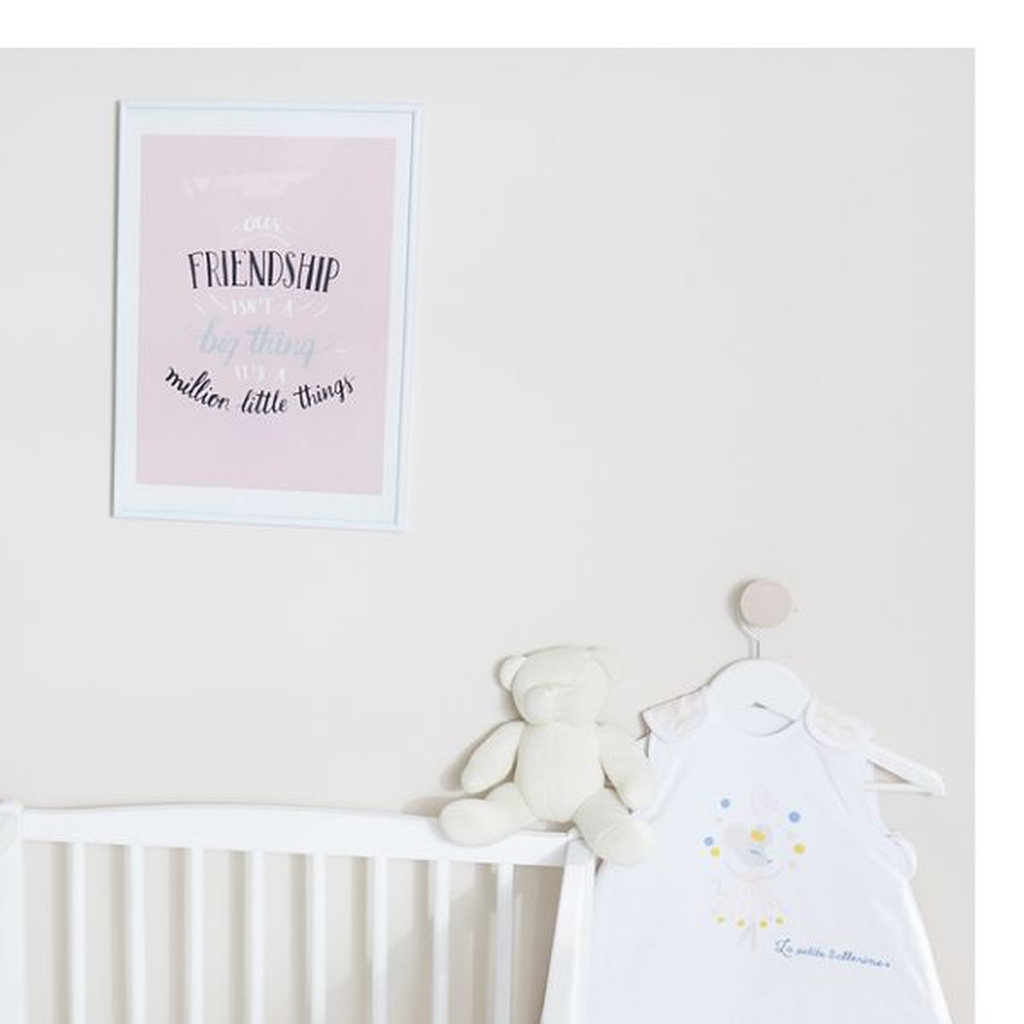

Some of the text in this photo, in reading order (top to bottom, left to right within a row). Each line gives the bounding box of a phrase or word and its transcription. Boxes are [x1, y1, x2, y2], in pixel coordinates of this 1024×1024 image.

[187, 249, 340, 293] FRIENDSHIP
[231, 297, 272, 315] ISN'T
[244, 324, 315, 369] thing
[164, 366, 356, 415] million little things
[775, 939, 793, 958] La
